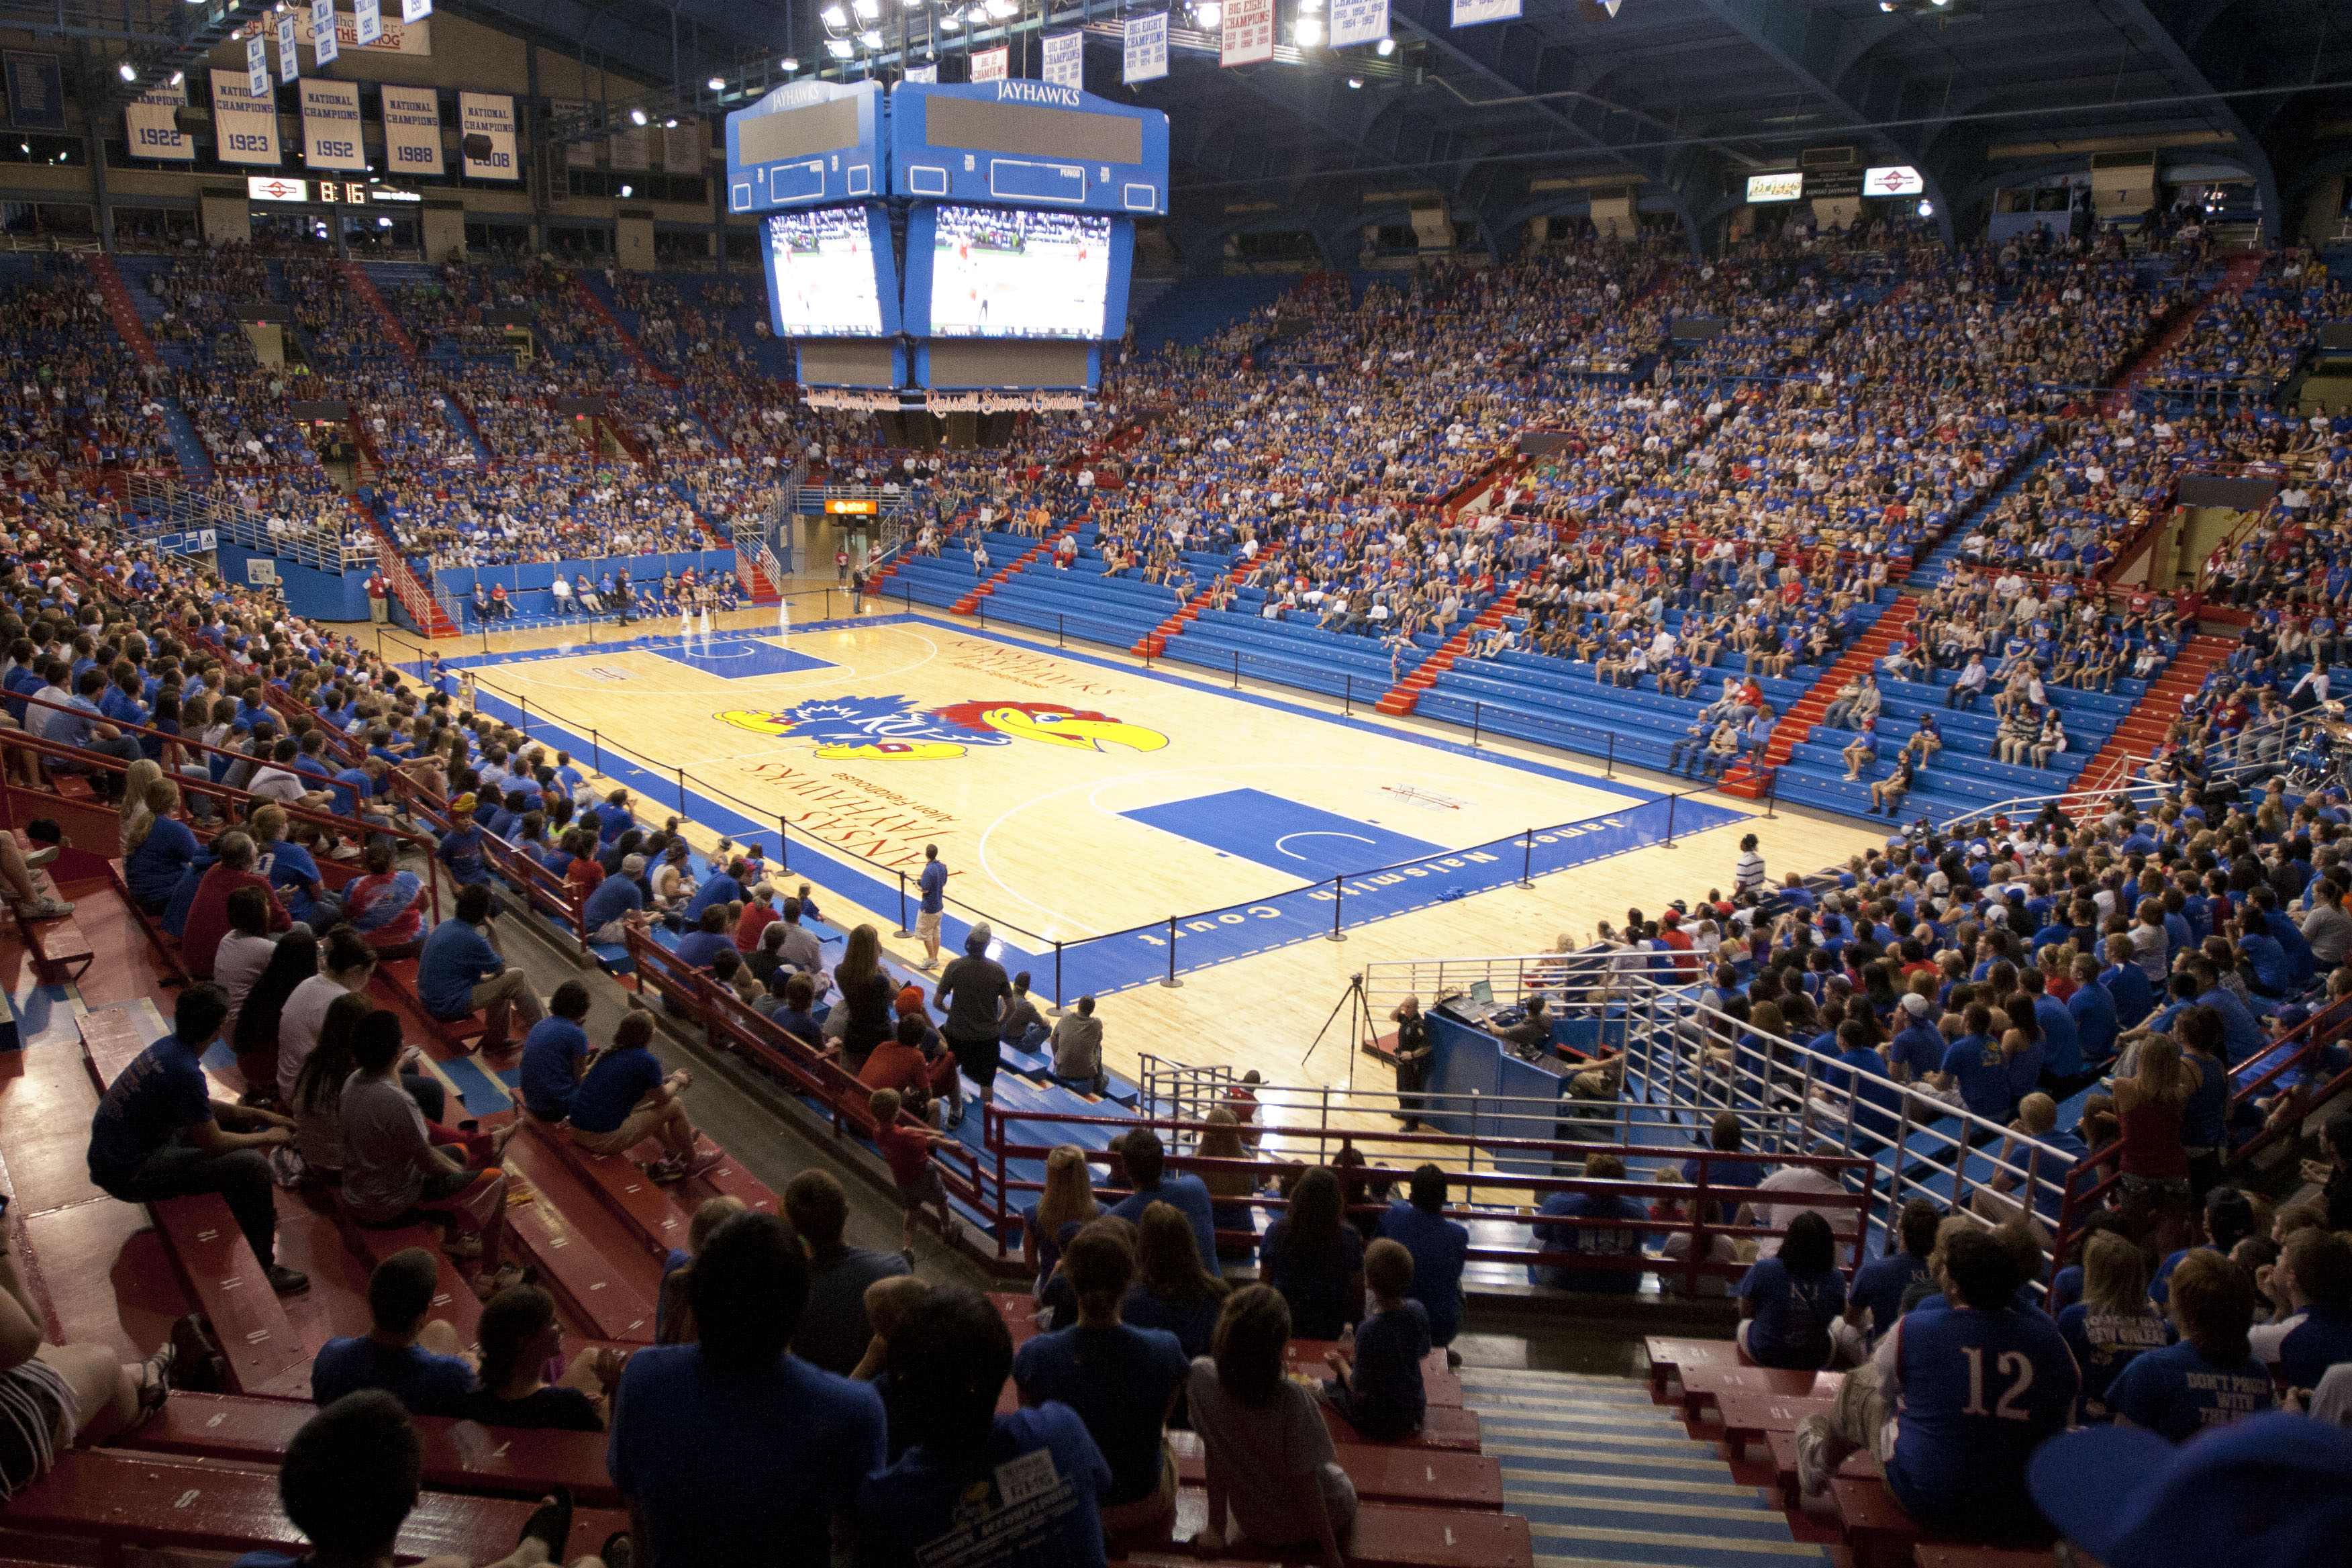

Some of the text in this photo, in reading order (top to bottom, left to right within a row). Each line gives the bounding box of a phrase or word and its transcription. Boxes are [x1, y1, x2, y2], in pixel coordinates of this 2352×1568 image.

[1228, 0, 1266, 14] BIG EIGHT
[1130, 17, 1162, 34] BIG EIGHT
[1225, 10, 1269, 30] CHAMPIONS
[1048, 42, 1058, 53] BIG
[1127, 31, 1164, 48] CHAMPIONS
[1045, 49, 1080, 64] CHAMPIONS
[308, 93, 352, 105] NATIONAL
[773, 85, 820, 111] JAYHAWKS
[998, 80, 1080, 106] JAYHAWKS
[216, 100, 274, 113] CHAMPIONS
[304, 107, 358, 120] CHAMPIONS
[390, 100, 432, 112] NATIONAL
[468, 107, 509, 119] NATIONAL
[386, 114, 438, 126] CHAMPIONS
[464, 121, 514, 132] CHAMPIONS
[140, 128, 182, 146] 1922
[230, 134, 268, 152] 1923
[317, 140, 354, 158] 1952
[397, 146, 433, 162] 1988
[1751, 177, 1800, 195] Briggs
[2117, 189, 2127, 202] 7
[925, 389, 1084, 418] Russell Stover Candies
[948, 640, 1069, 668] KANSAS
[949, 654, 1126, 695] JAYHAWKS
[847, 714, 944, 737] KU
[740, 763, 961, 841] JAYHAWKS
[831, 773, 961, 822] Allen Fieldhouse
[1138, 818, 1626, 948] James Naismith Court
[1959, 1345, 2035, 1422] 12
